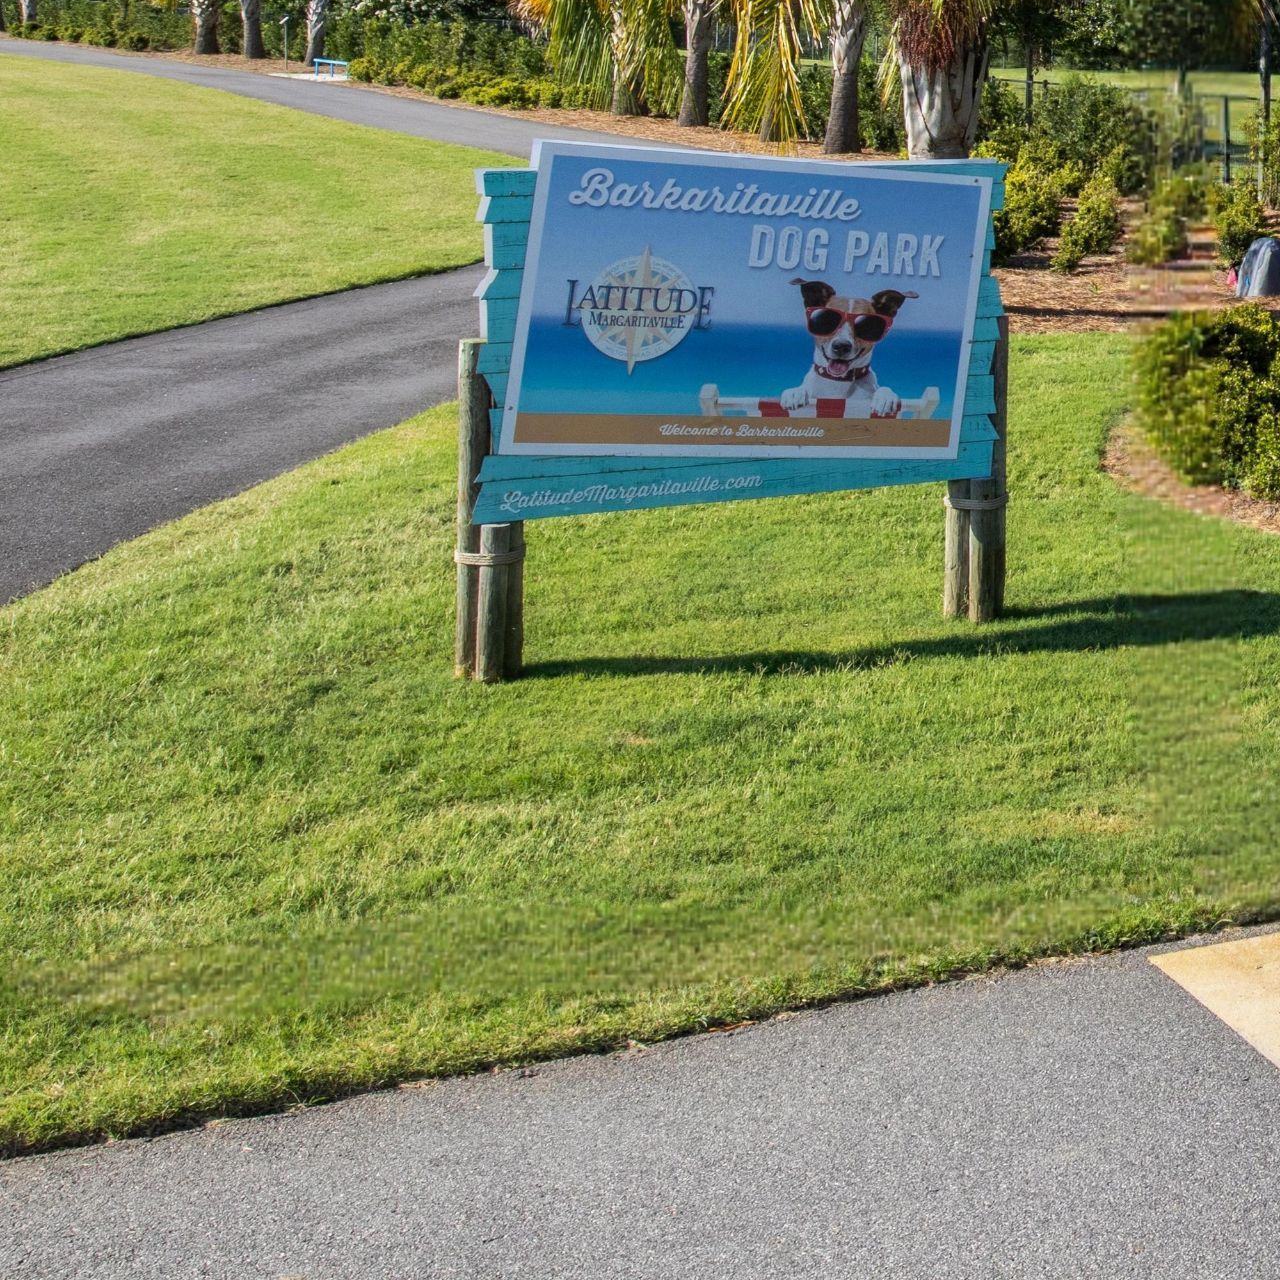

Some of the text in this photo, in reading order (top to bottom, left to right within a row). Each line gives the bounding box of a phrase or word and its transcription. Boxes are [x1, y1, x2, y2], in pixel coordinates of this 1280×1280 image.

[567, 167, 862, 221] Barkaritaville
[748, 224, 830, 272] DOG
[843, 230, 945, 278] PARK
[562, 279, 715, 330] LATITUDE
[588, 311, 686, 329] MARGARITAVILLE
[659, 424, 826, 438] Welcome to Barkaritaville
[500, 473, 763, 513] LatitudeMargaritaville.com
